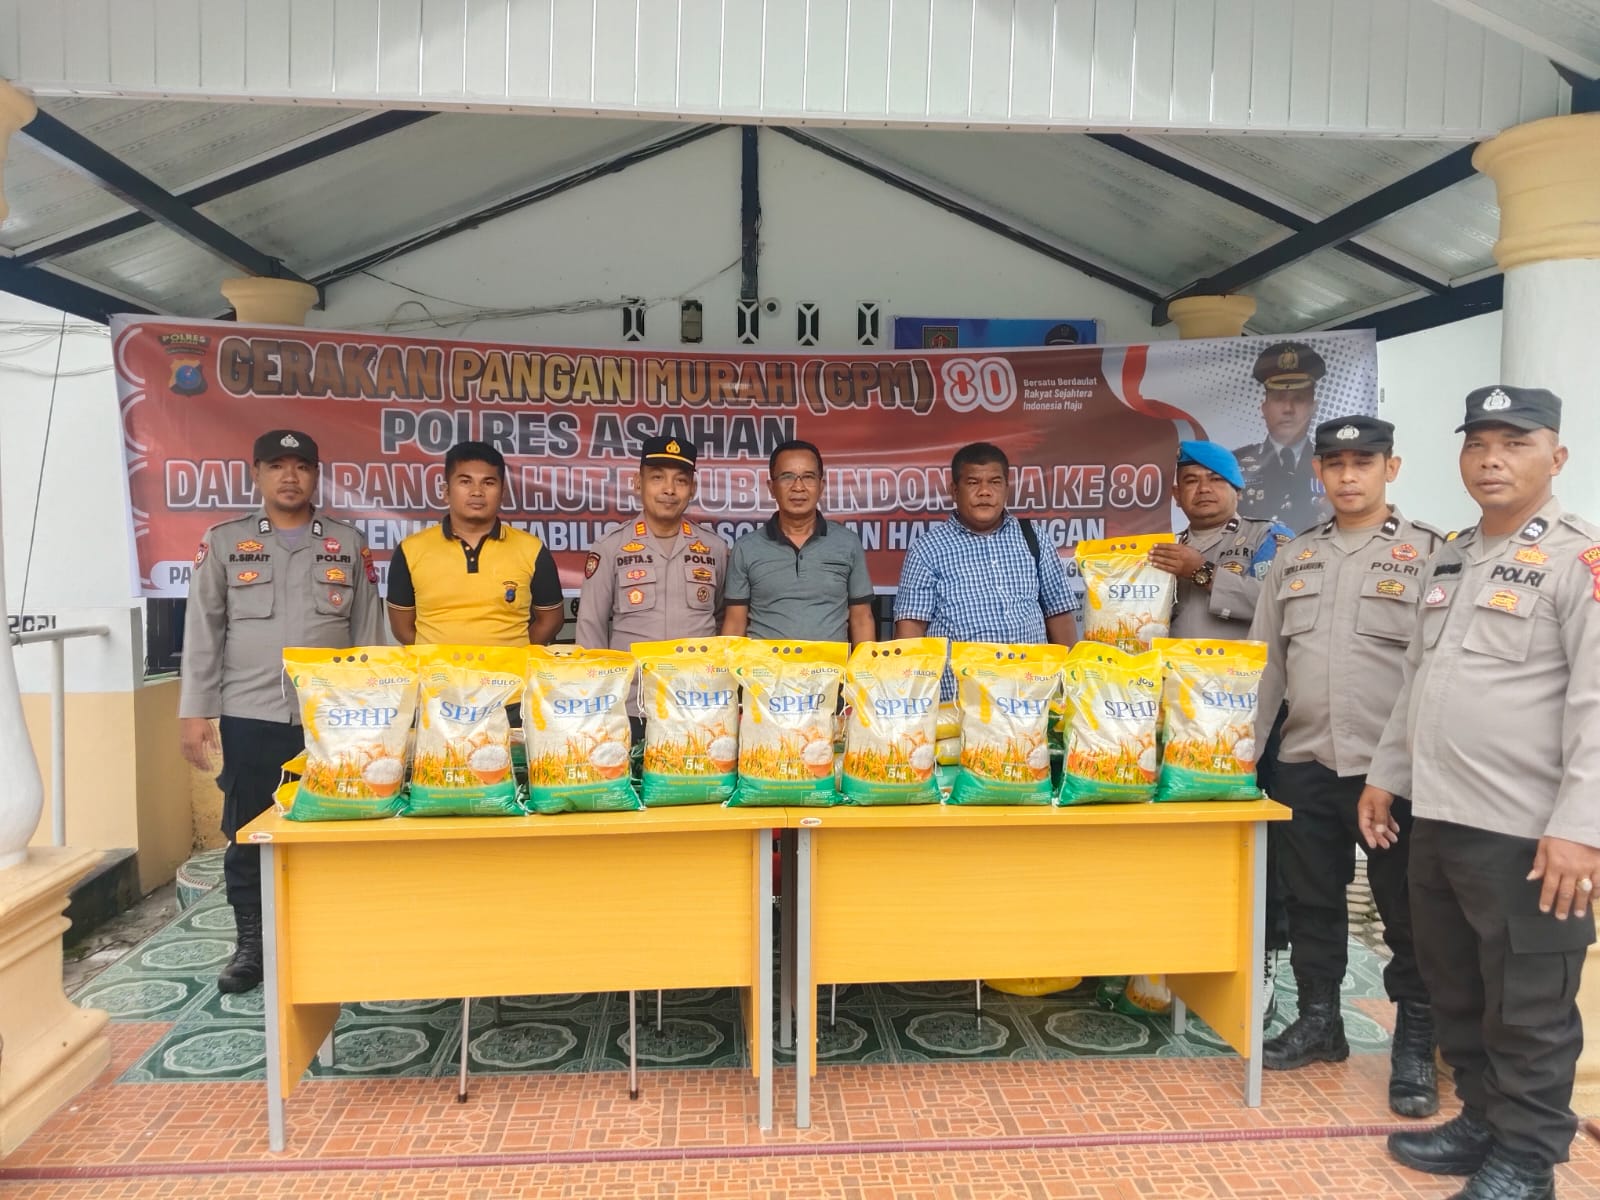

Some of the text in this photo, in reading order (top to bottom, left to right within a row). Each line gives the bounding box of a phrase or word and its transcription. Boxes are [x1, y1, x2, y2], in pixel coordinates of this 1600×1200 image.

[218, 335, 936, 416] GERAKAN PANGAN MURAH (GPM)
[1024, 377, 1097, 387] Bersatu Berdaulat
[942, 357, 1017, 413] 80
[1025, 388, 1092, 400] Rakyat Sejahtera
[1024, 401, 1083, 411] Indonesia Maju
[522, 465, 610, 511] HUT
[1053, 465, 1105, 508] KE
[1109, 463, 1163, 508] 80
[316, 554, 351, 563] POLRI
[684, 555, 716, 566] POLRI
[1219, 547, 1254, 559] POLRI
[1370, 561, 1419, 577] POLRI
[1491, 564, 1545, 588] POLRI
[1108, 584, 1160, 599] SPHP
[553, 694, 617, 715] SPHP
[675, 690, 734, 706] SPHP
[769, 694, 826, 712] SPHP
[1202, 691, 1257, 708] SPHP
[874, 698, 932, 716] SPHP
[1104, 700, 1157, 718] SPHP
[328, 707, 398, 726] SPHP
